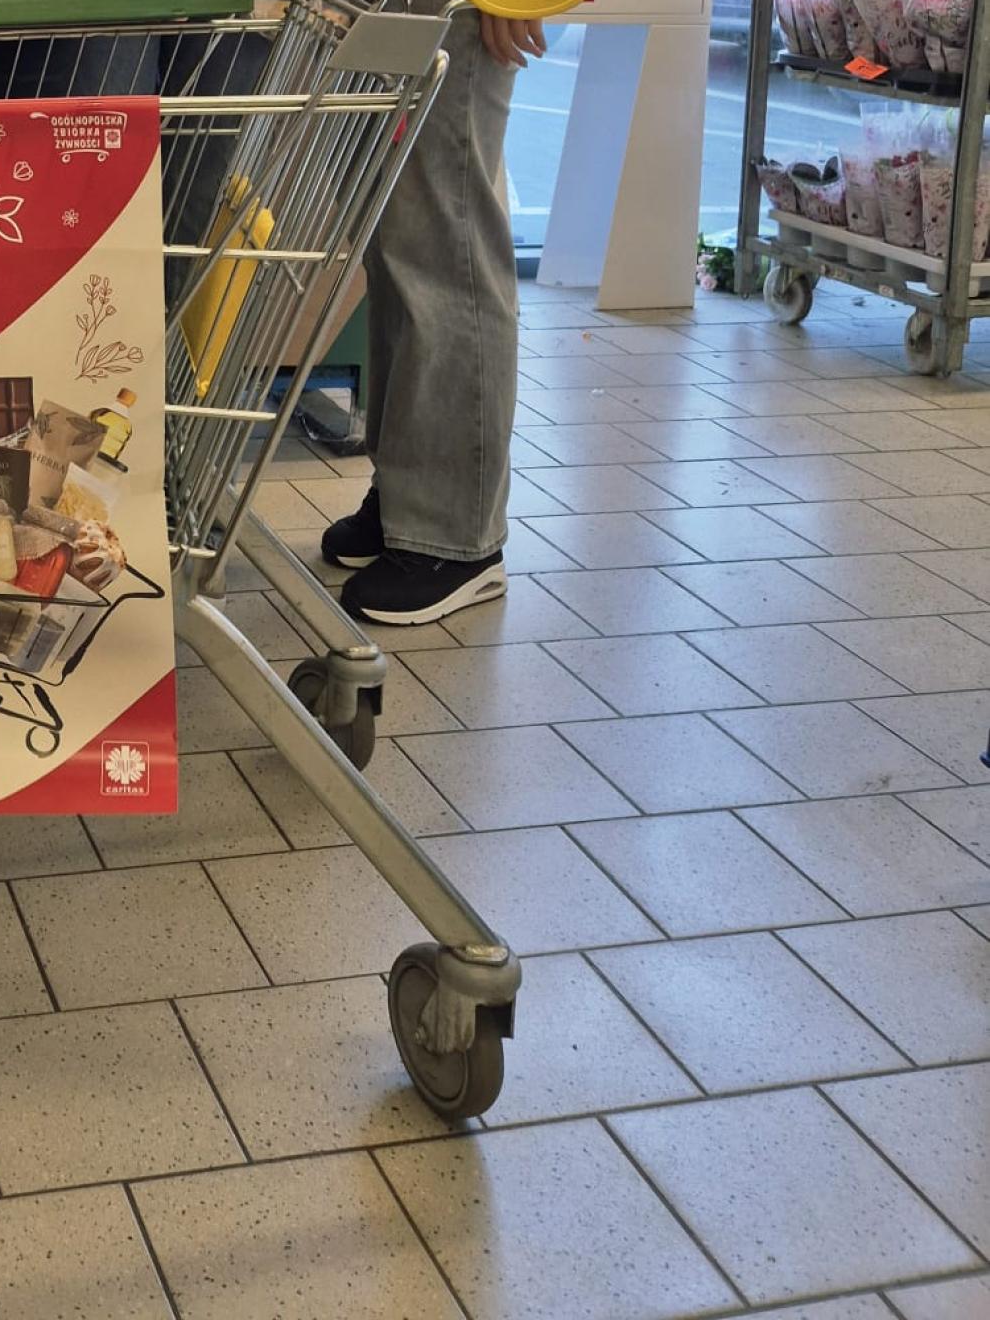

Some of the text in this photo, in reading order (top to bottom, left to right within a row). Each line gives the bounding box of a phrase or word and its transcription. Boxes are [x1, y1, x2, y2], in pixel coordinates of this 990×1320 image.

[51, 114, 123, 126] OGÓLNOPOLSKA
[53, 126, 100, 137] ZBIÓRKA
[55, 137, 100, 149] ŻYWNOŚCI
